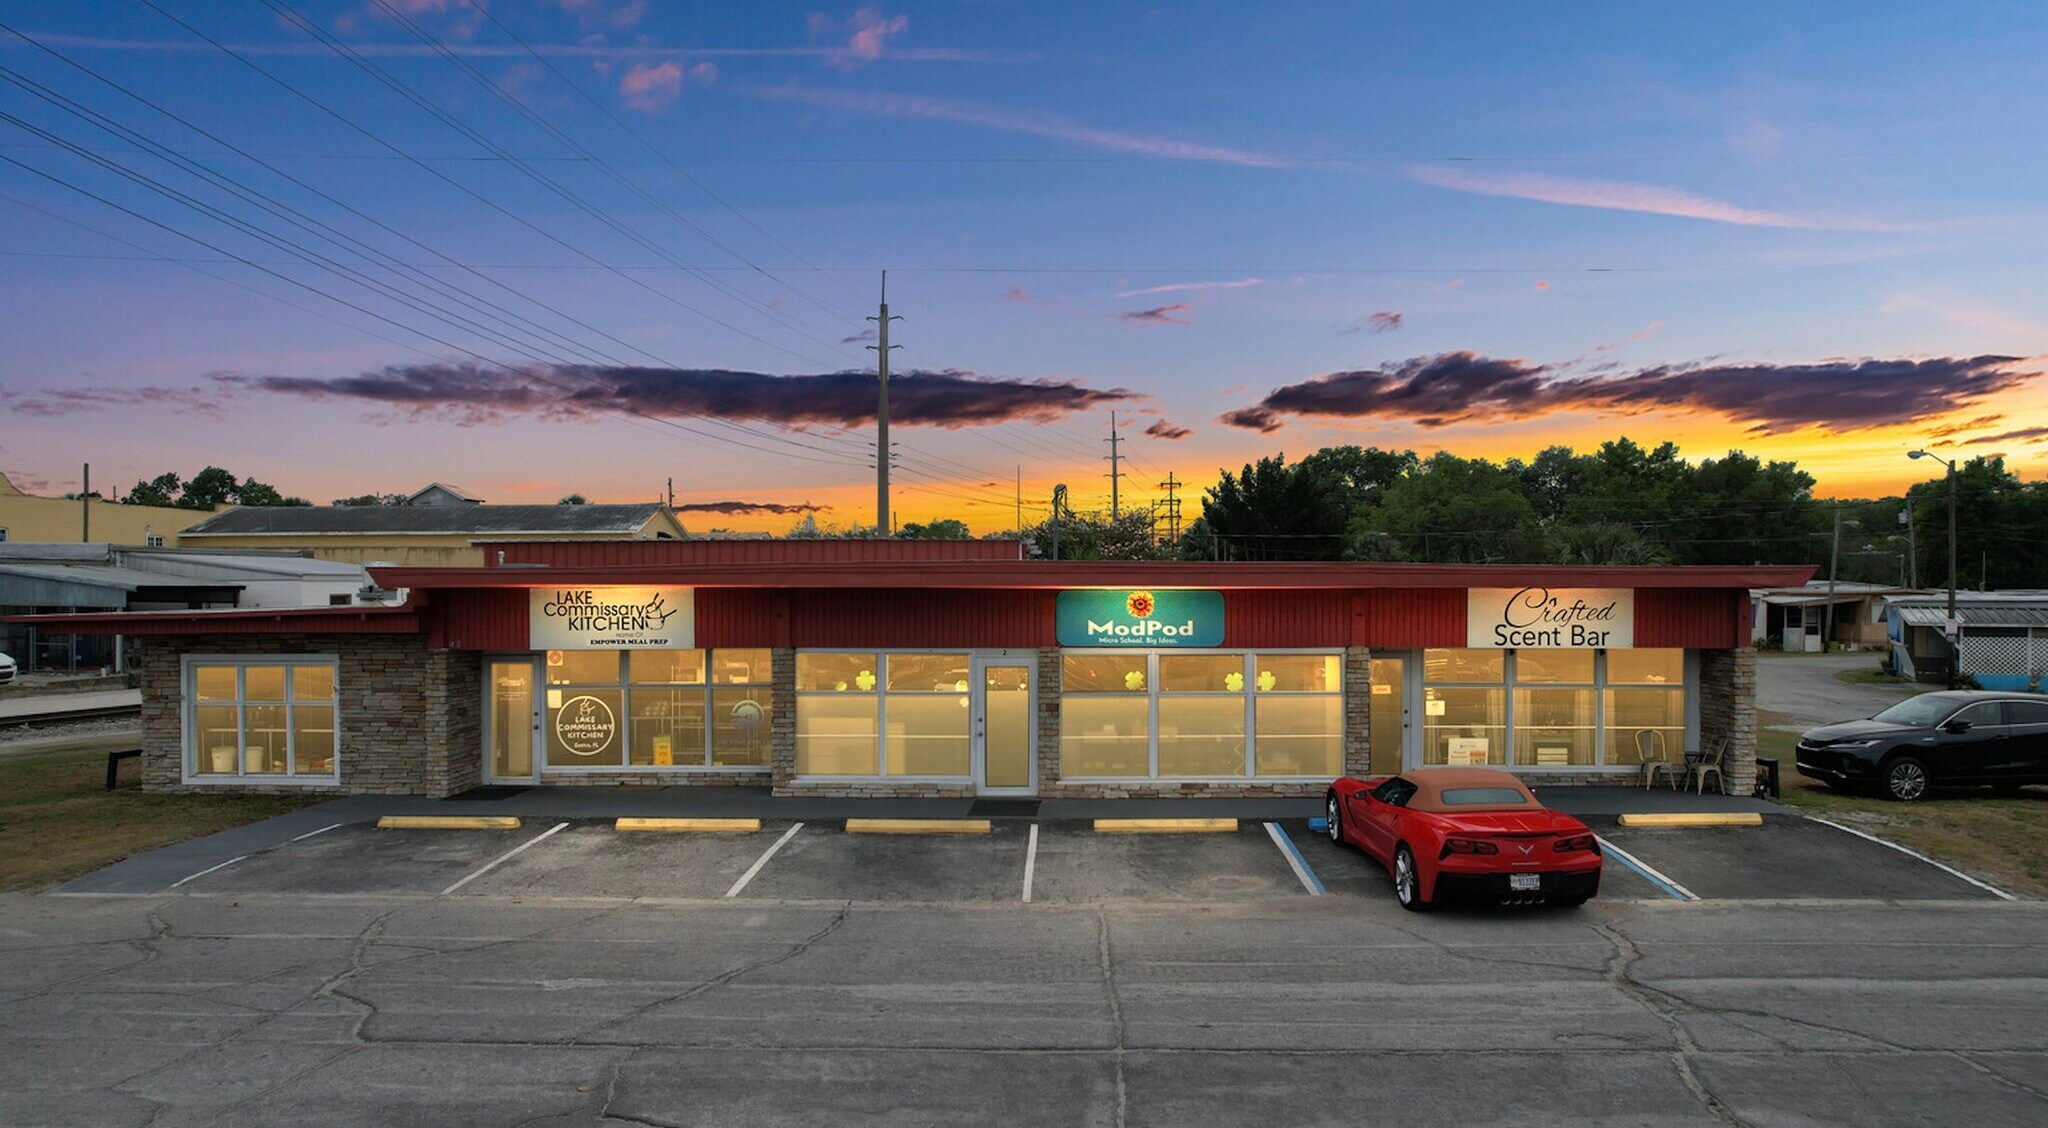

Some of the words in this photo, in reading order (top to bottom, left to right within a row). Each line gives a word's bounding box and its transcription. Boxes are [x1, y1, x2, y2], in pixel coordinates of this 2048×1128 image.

[557, 591, 592, 604] LAKE
[544, 602, 645, 619] Commissary
[1504, 586, 1616, 628] Crafted
[568, 616, 644, 631] KITCHEN
[1087, 619, 1193, 636] ModPod
[1098, 636, 1119, 644] Micro
[1146, 636, 1157, 645] Big
[1494, 624, 1561, 647] Scent
[1571, 624, 1610, 647] Bar
